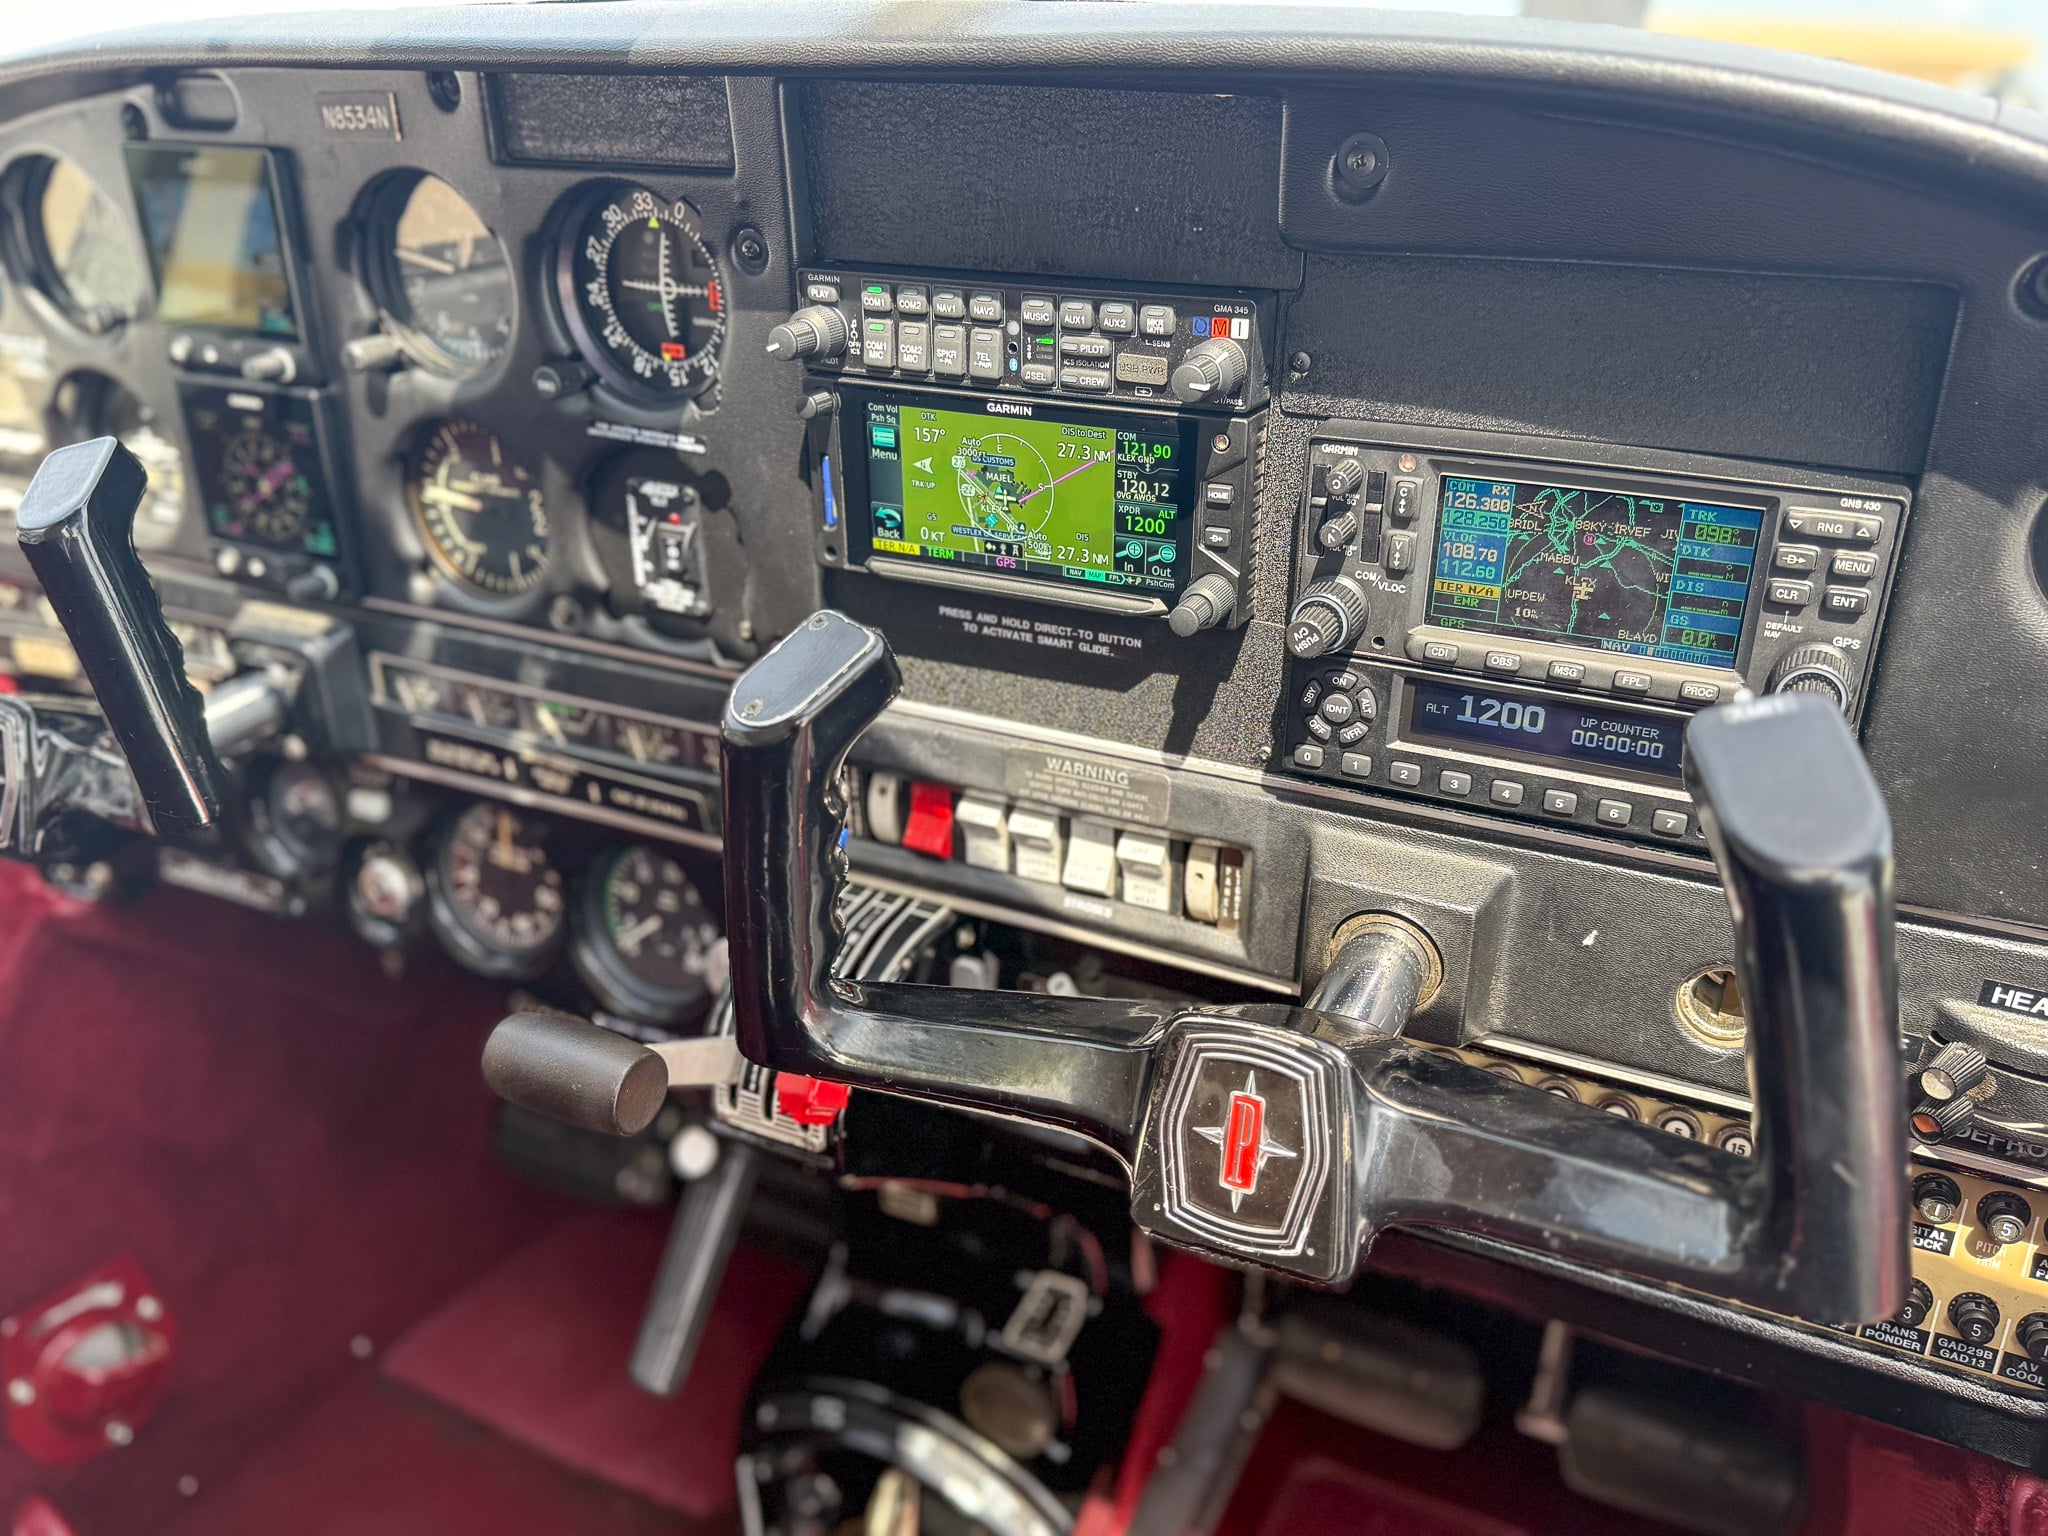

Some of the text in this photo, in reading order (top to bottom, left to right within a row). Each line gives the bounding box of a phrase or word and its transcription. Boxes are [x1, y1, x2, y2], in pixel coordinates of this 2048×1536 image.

[808, 274, 841, 284] GARMIN
[811, 289, 829, 299] PLAY
[863, 298, 886, 308] COM1
[899, 299, 922, 310] COM2
[936, 303, 957, 313] NAV1
[1213, 303, 1249, 315] GMA 345
[973, 307, 996, 317] NAV2
[1023, 311, 1050, 323] MUSIC
[1064, 315, 1086, 326] AUX1
[1103, 319, 1127, 330] AUX2
[1146, 317, 1165, 328] MKR
[866, 340, 889, 352] COM1
[900, 343, 924, 356] COM2
[1080, 343, 1105, 355] PILOT
[1152, 341, 1171, 349] SENS
[869, 349, 885, 361] MIC
[903, 353, 919, 365] MIC
[936, 348, 957, 361] SPKR
[976, 351, 991, 363] TEL
[1064, 359, 1110, 371] ICS ISOLATION
[1119, 361, 1165, 377] USB PWR
[1031, 372, 1047, 383] SEL
[1080, 375, 1106, 387] CREW
[868, 402, 899, 414] Com Vol
[986, 402, 1033, 417] GARMIN
[871, 413, 885, 423] Psh
[920, 412, 937, 422] DTK
[1061, 426, 1107, 441] DIS to Dest
[1117, 431, 1137, 442] COM
[961, 437, 982, 448] Auto
[872, 447, 898, 461] Menu
[957, 446, 978, 458] 3000
[1057, 442, 1111, 463] 27.3 NM
[1122, 440, 1172, 460] 121.90
[1321, 443, 1359, 457] GARMIN
[982, 456, 1015, 467] CUSTOMS
[1117, 452, 1156, 465] KLEX GND
[985, 472, 1013, 484] MAJEL
[1117, 469, 1139, 480] STBY
[926, 481, 936, 489] UP
[1121, 478, 1170, 498] 120.12
[1448, 480, 1510, 496] COM RX
[1133, 493, 1157, 503] AWOS
[1207, 489, 1230, 501] HOME
[1331, 492, 1361, 502] VOL PUSH
[1346, 498, 1357, 507] SQ
[1445, 491, 1511, 513] 126.300
[1839, 498, 1882, 512] GNS 430
[926, 512, 937, 521] GS
[1118, 504, 1175, 520] XPDR ALT
[1688, 508, 1718, 522] TRK
[1125, 514, 1166, 535] 1200
[1443, 509, 1508, 529] 128.250
[1575, 518, 1606, 531] 88KY
[878, 526, 900, 540] Back
[1816, 521, 1844, 535] RNG
[931, 531, 945, 543] KT
[1027, 531, 1048, 541] Auto
[1076, 532, 1090, 542] DIS
[1443, 530, 1477, 543] VLOC
[878, 538, 916, 553] TER N/A
[1442, 542, 1498, 562] 108.70
[1681, 545, 1711, 558] DTK
[926, 546, 955, 560] TERM
[1057, 545, 1090, 563] 27.3
[1092, 553, 1110, 566] NM
[996, 556, 1017, 569] GPS
[1123, 562, 1135, 573] In
[1440, 558, 1496, 579] 112.60
[1834, 560, 1871, 574] MENU
[1069, 568, 1083, 577] NAV
[1108, 573, 1122, 583] FPL
[1151, 565, 1172, 578] Out
[1145, 577, 1176, 590] PshCom
[1440, 581, 1495, 597] TER N/A
[1675, 579, 1705, 593] DIS
[1775, 588, 1798, 601] CLR
[1831, 595, 1858, 609] ENT
[1440, 618, 1466, 629] GPS
[1669, 614, 1689, 626] GS
[938, 604, 1143, 650] PRESS AND HOLD DIRECT-TO BUTTON
[1765, 621, 1804, 634] DEFAULT
[962, 621, 1117, 658] TO ACTIVATE SMART GLIDE.
[1617, 628, 1657, 644] BLAYD
[1763, 629, 1782, 640] NAV
[1604, 639, 1631, 653] NAV
[1832, 635, 1862, 650] GPS
[1430, 647, 1449, 659] CDI
[1491, 656, 1513, 667] OBS
[1554, 665, 1578, 677] MSG
[1332, 676, 1347, 686] ON
[1621, 674, 1643, 687] FPL
[1303, 686, 1317, 704] SBY
[1684, 684, 1714, 698] PROC
[1326, 702, 1348, 715] IDNT
[1361, 698, 1372, 715] ALT
[1425, 694, 1546, 734] ALT 1200
[1308, 718, 1326, 736] OFF
[1580, 716, 1660, 740] UP COUNTER
[1343, 727, 1362, 741] VFR
[1571, 728, 1664, 760] 00:00:00
[1303, 752, 1312, 762] 0
[1045, 756, 1130, 785] WARNING
[1352, 760, 1359, 770] 1
[1400, 769, 1409, 780] 2
[1450, 779, 1459, 789] 3
[1501, 788, 1511, 799] 4
[1555, 798, 1565, 809] 5
[1609, 808, 1619, 819] 6
[1665, 817, 1676, 829] 7
[1731, 1142, 1747, 1156] 15
[1975, 1240, 2008, 1257] PITCH
[1976, 1254, 2002, 1272] TRIM
[1902, 1306, 1913, 1320] 3
[1875, 1321, 1919, 1341] TRANS
[1971, 1324, 1982, 1339] 5
[1866, 1327, 1922, 1352] PONDER
[1937, 1336, 1994, 1360] GAD29B
[1939, 1348, 1986, 1369] GAD13
[2005, 1367, 2046, 1387] COOL
